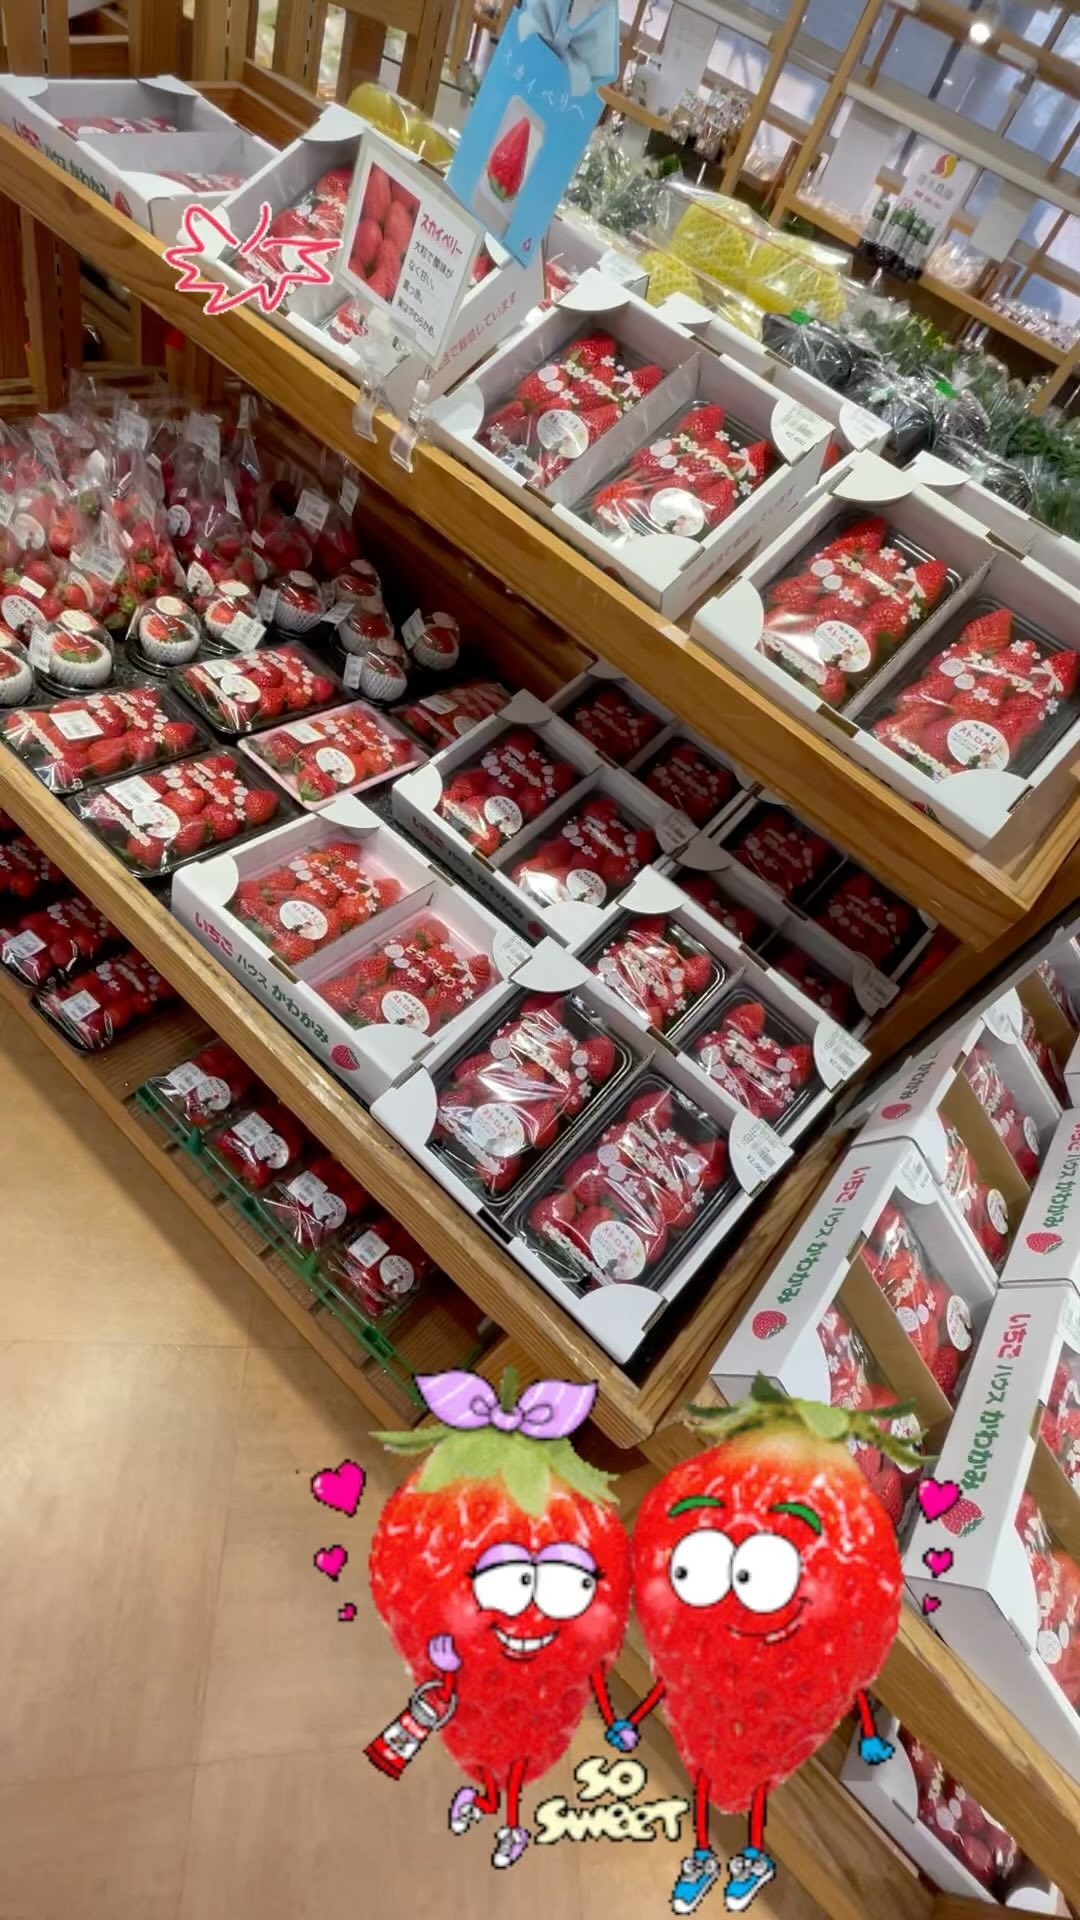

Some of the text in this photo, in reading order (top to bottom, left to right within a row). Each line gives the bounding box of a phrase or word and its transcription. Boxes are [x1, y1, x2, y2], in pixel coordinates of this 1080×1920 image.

[420, 212, 463, 256] スカイベリー
[194, 911, 233, 957] いちご
[236, 953, 268, 990] ハウス
[270, 983, 329, 1034] かわかみ
[776, 1165, 872, 1305] いちご ハウス かわかみ
[1042, 1180, 1077, 1229] かわかみ
[959, 1313, 1031, 1491] いちご ハウス かわかみ
